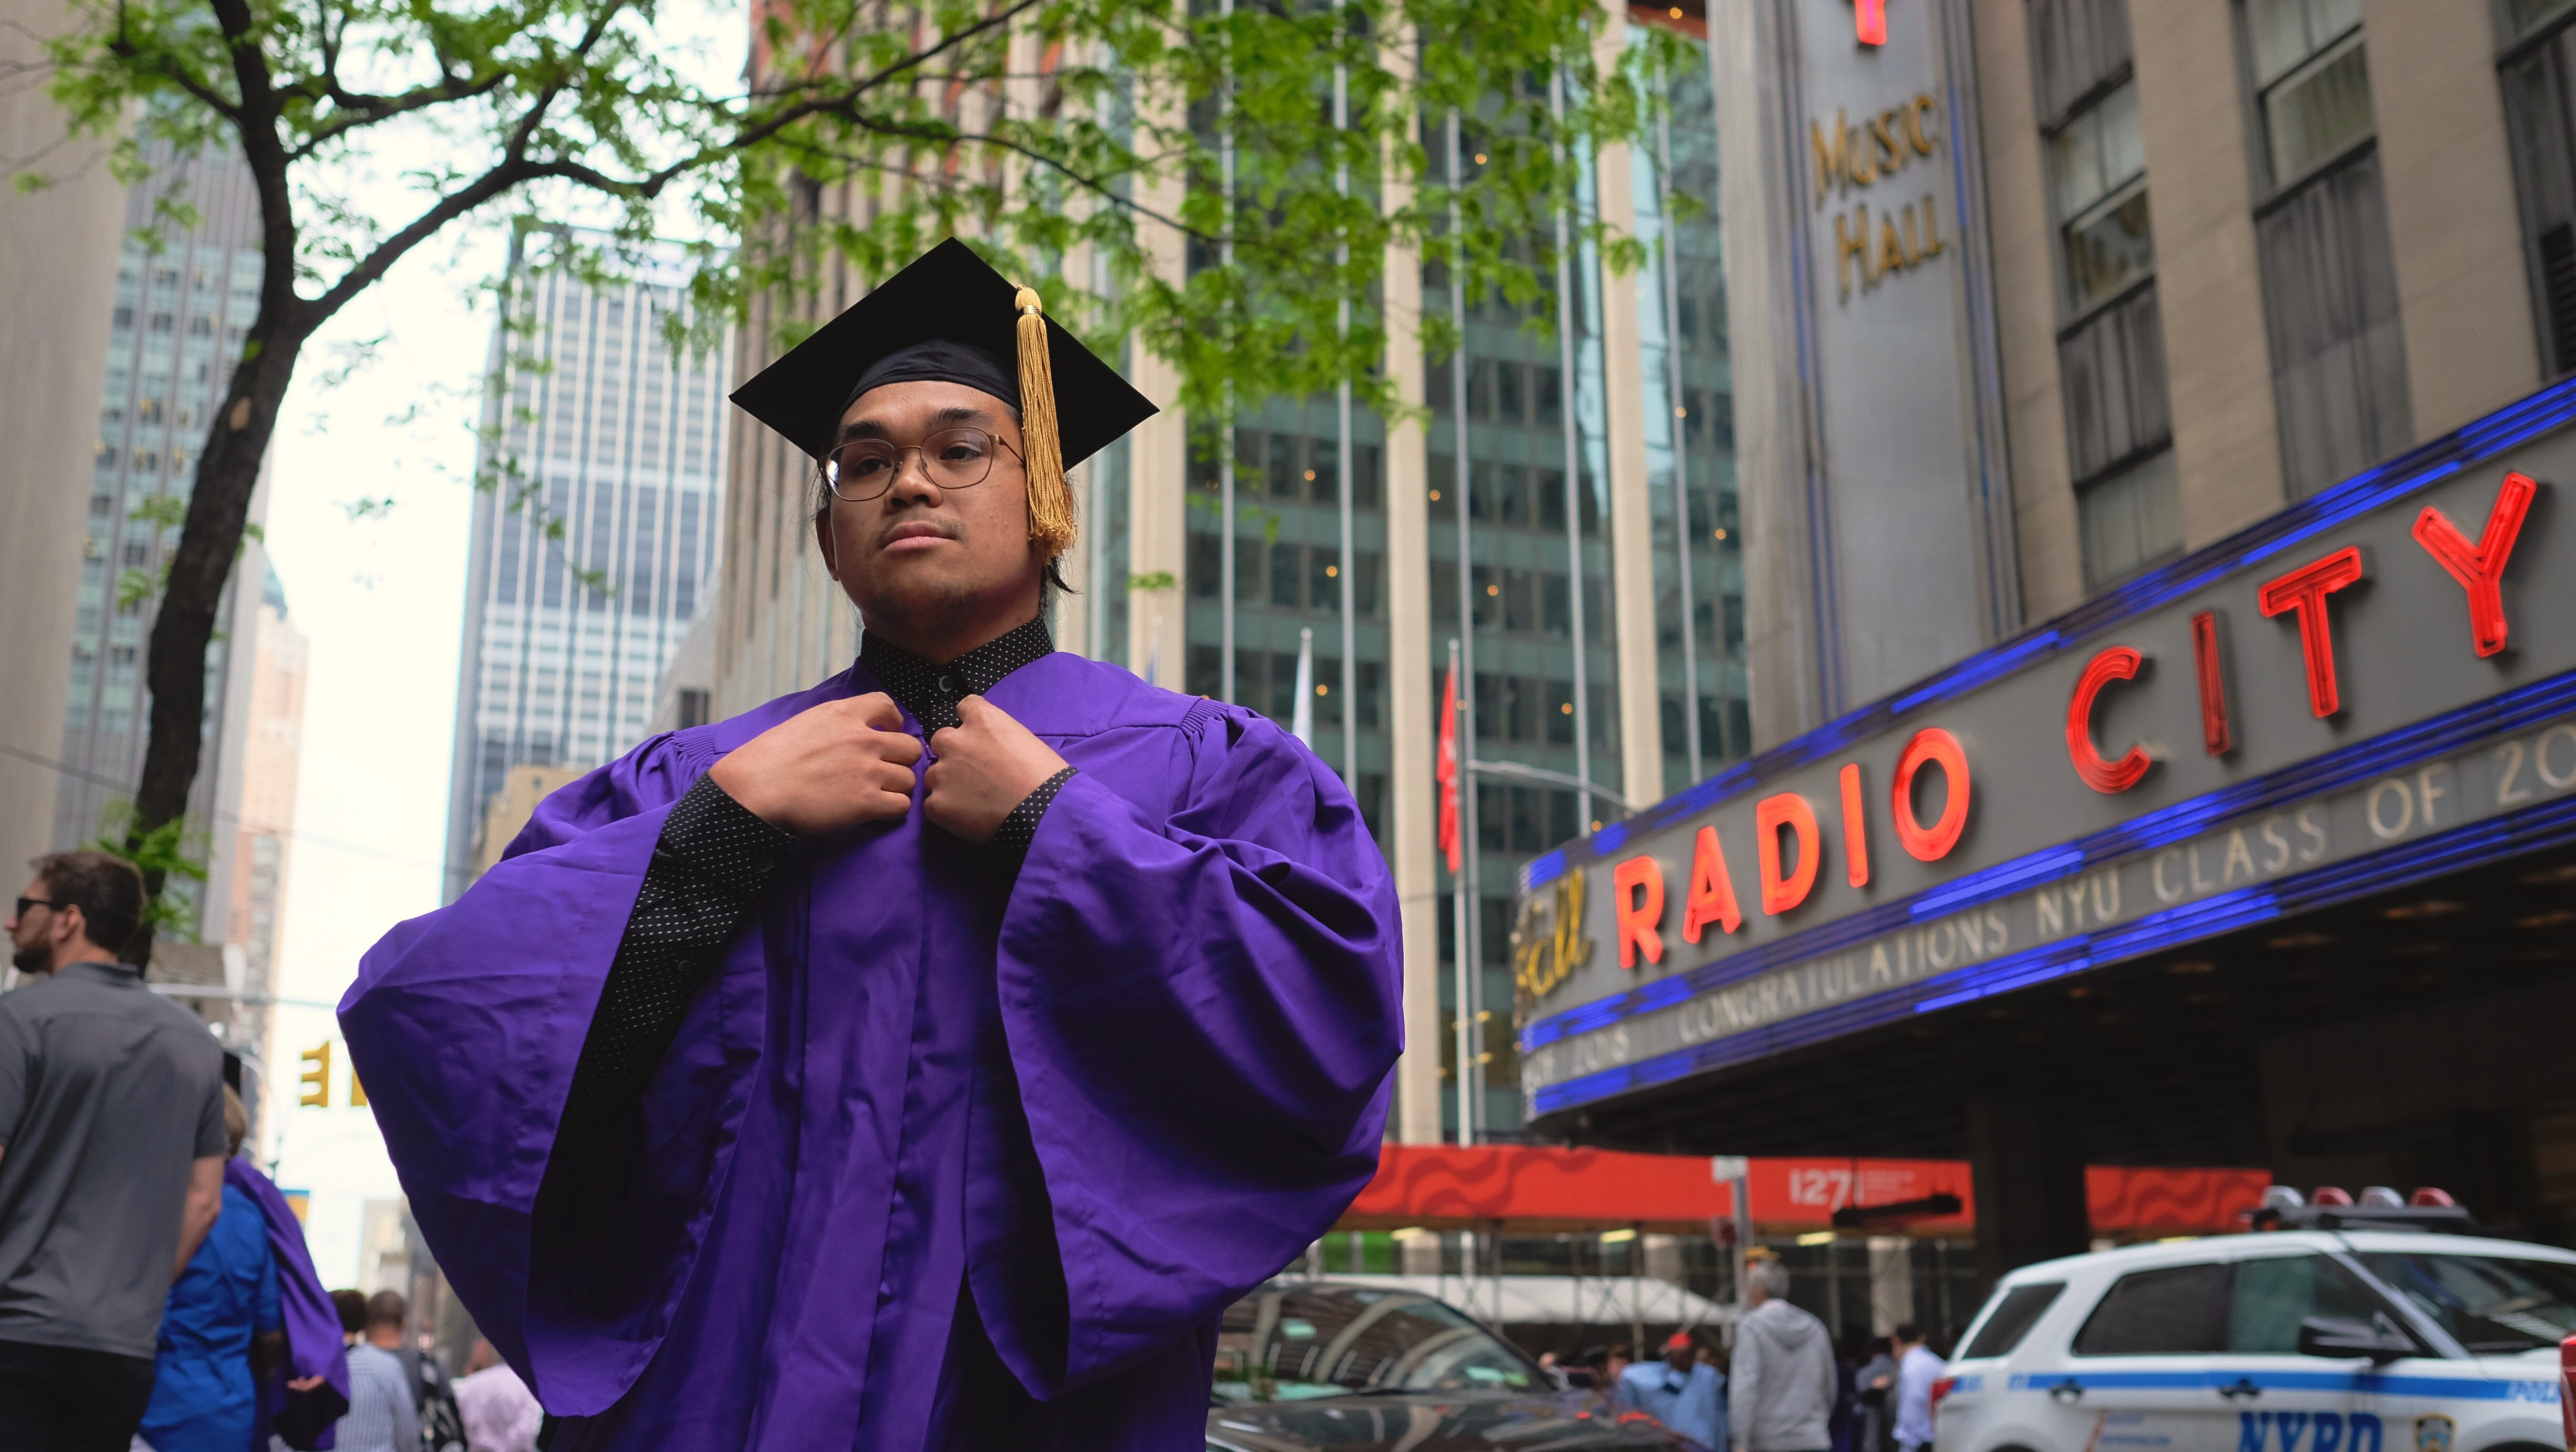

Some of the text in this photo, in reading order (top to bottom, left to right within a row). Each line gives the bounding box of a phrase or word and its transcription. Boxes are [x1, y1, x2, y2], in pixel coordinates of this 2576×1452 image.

[1614, 471, 2537, 969] RADIO CITY
[1677, 907, 2009, 1044] CONGRATULATIONS
[2035, 866, 2121, 942] NYU
[2152, 806, 2327, 903] CLASS
[2366, 762, 2447, 840] OF
